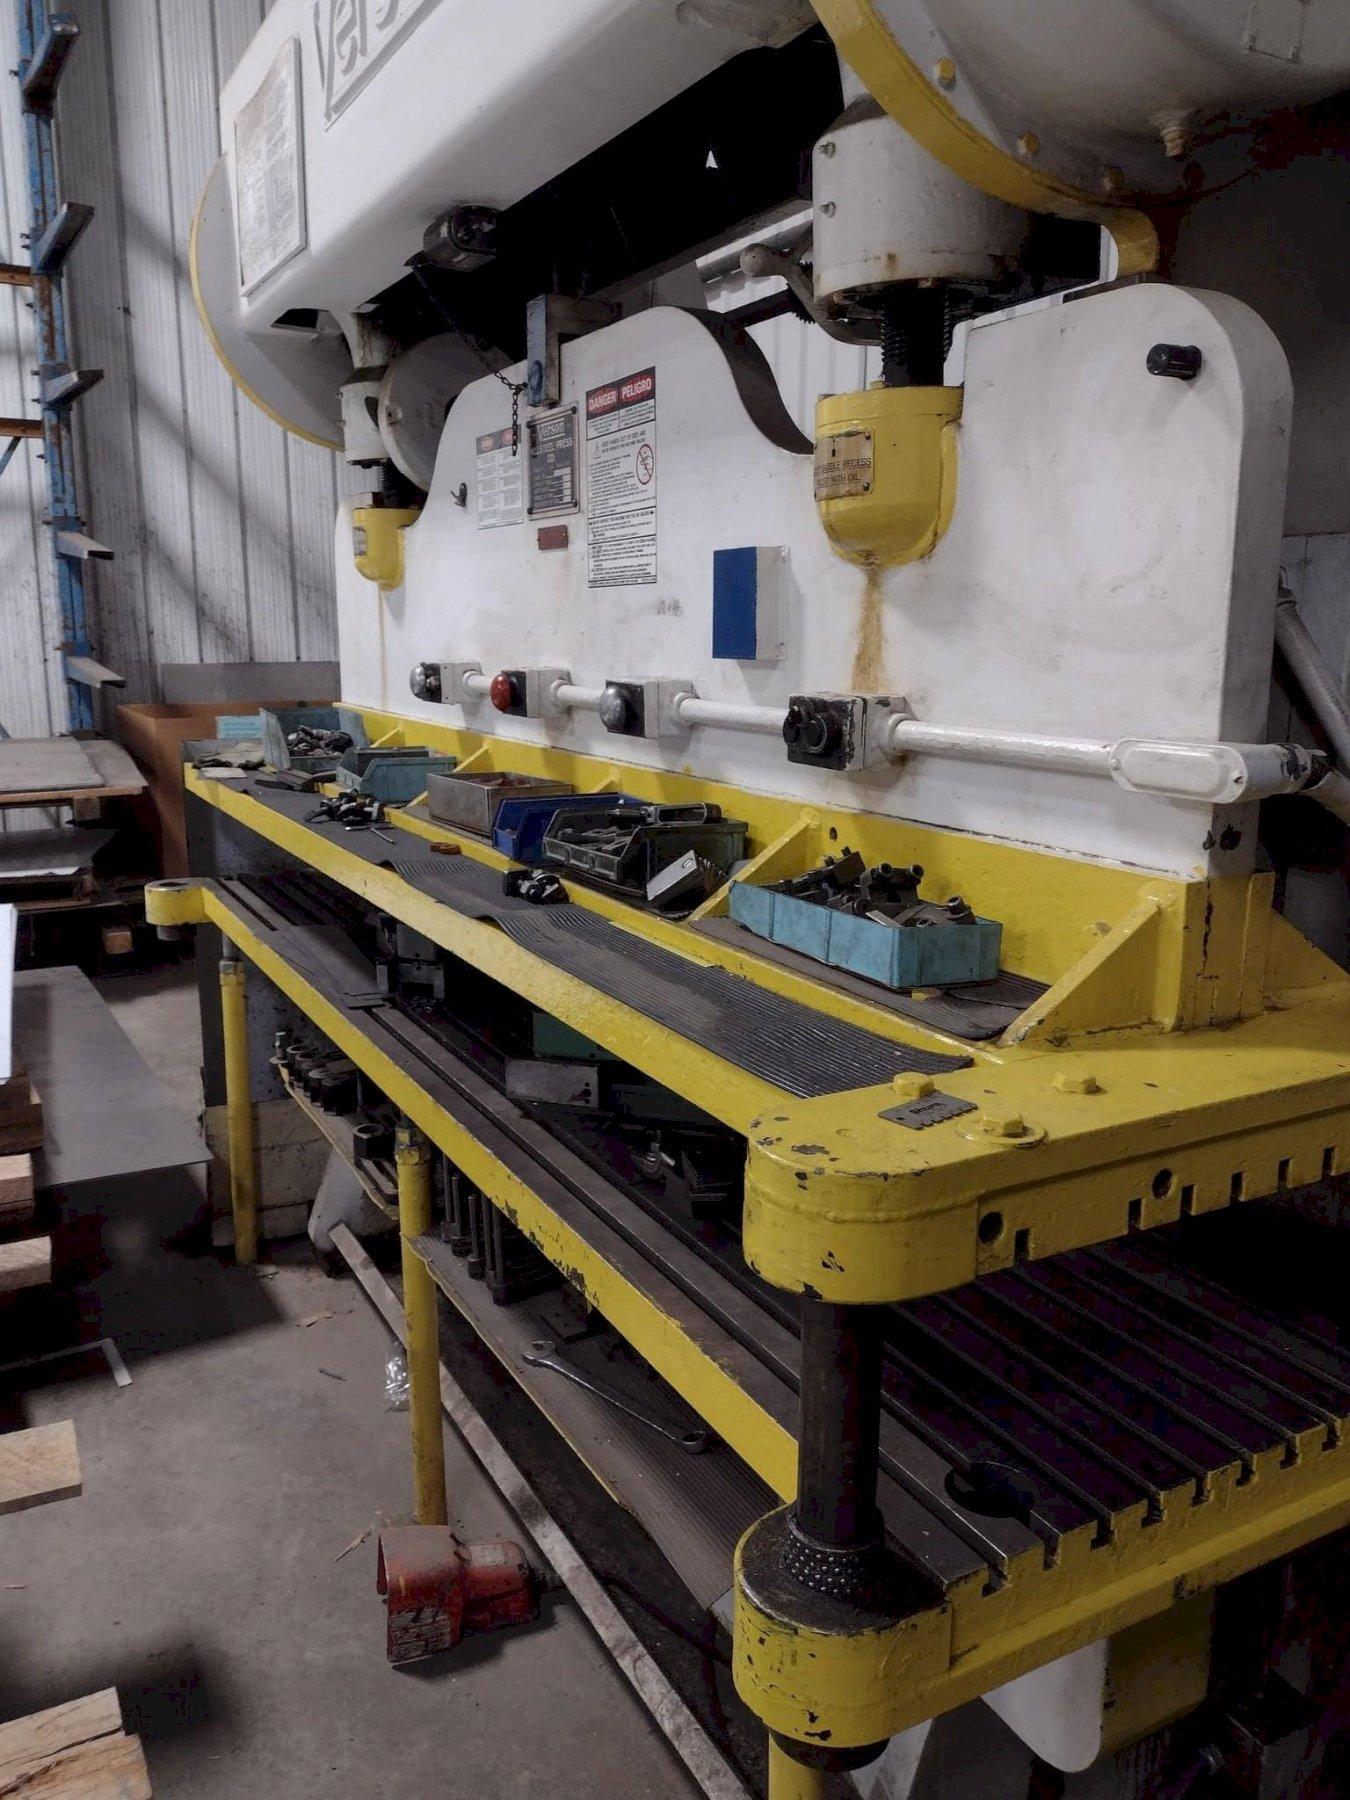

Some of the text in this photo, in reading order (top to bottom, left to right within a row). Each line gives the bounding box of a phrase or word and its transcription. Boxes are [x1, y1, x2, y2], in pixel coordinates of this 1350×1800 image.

[588, 378, 652, 411] DANGER PELIGRO
[555, 437, 573, 451] PRESS
[843, 457, 871, 468] RECESS
